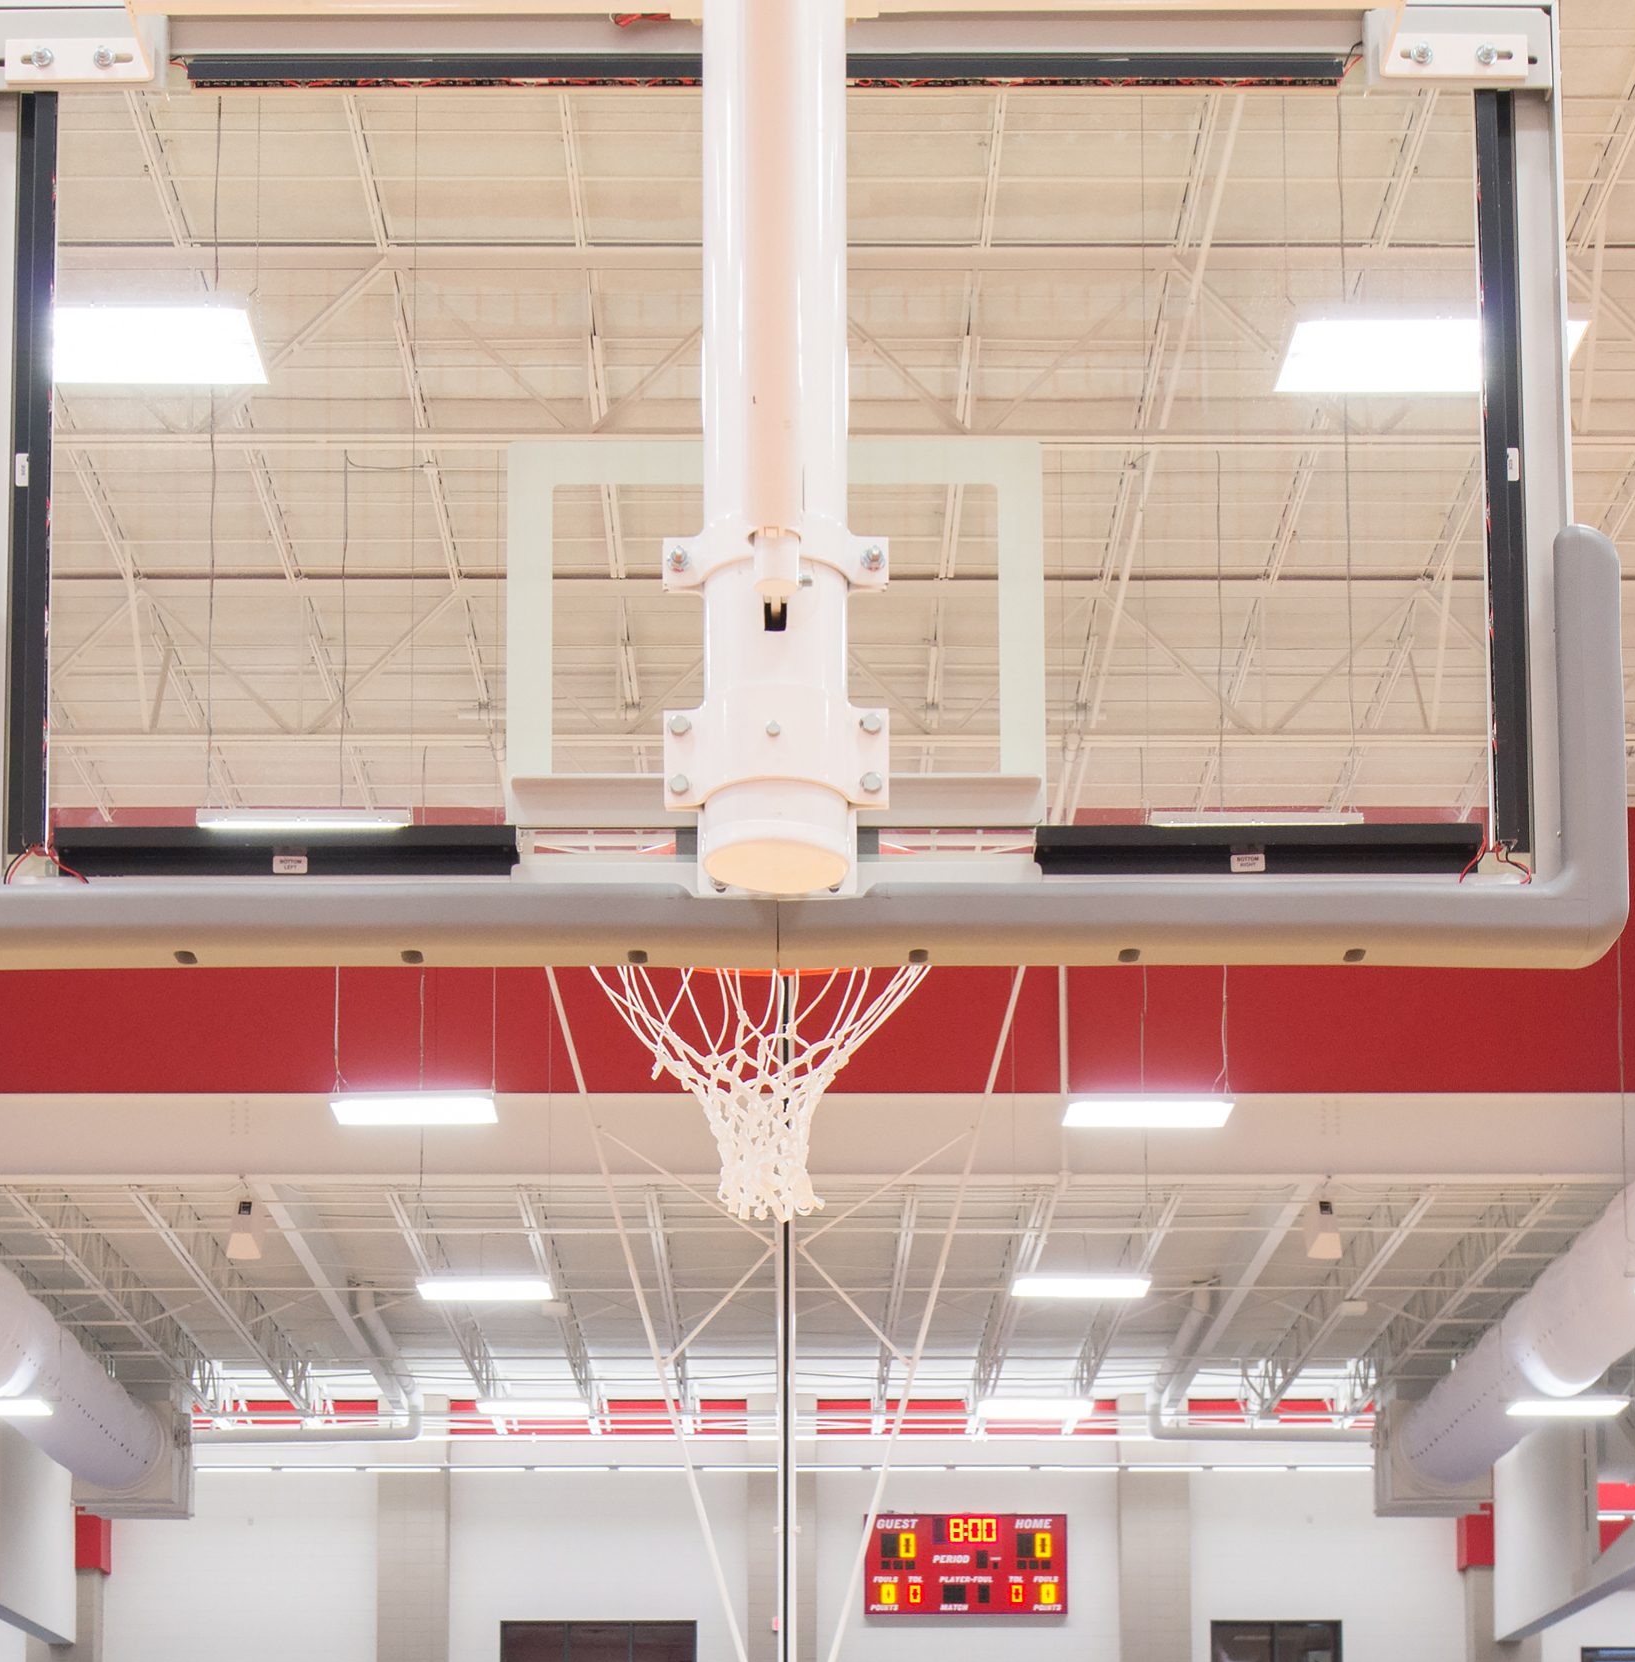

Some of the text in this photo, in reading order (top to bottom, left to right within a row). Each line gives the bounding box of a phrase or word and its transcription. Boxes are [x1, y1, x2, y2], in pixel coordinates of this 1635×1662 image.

[876, 1518, 919, 1529] GUEST
[1014, 1518, 1053, 1529] HOME
[948, 1517, 997, 1543] 8:00
[899, 1532, 916, 1559] 0
[1034, 1532, 1052, 1559] 0
[932, 1554, 970, 1564] PERIOD
[1033, 1575, 1059, 1583] FOULS
